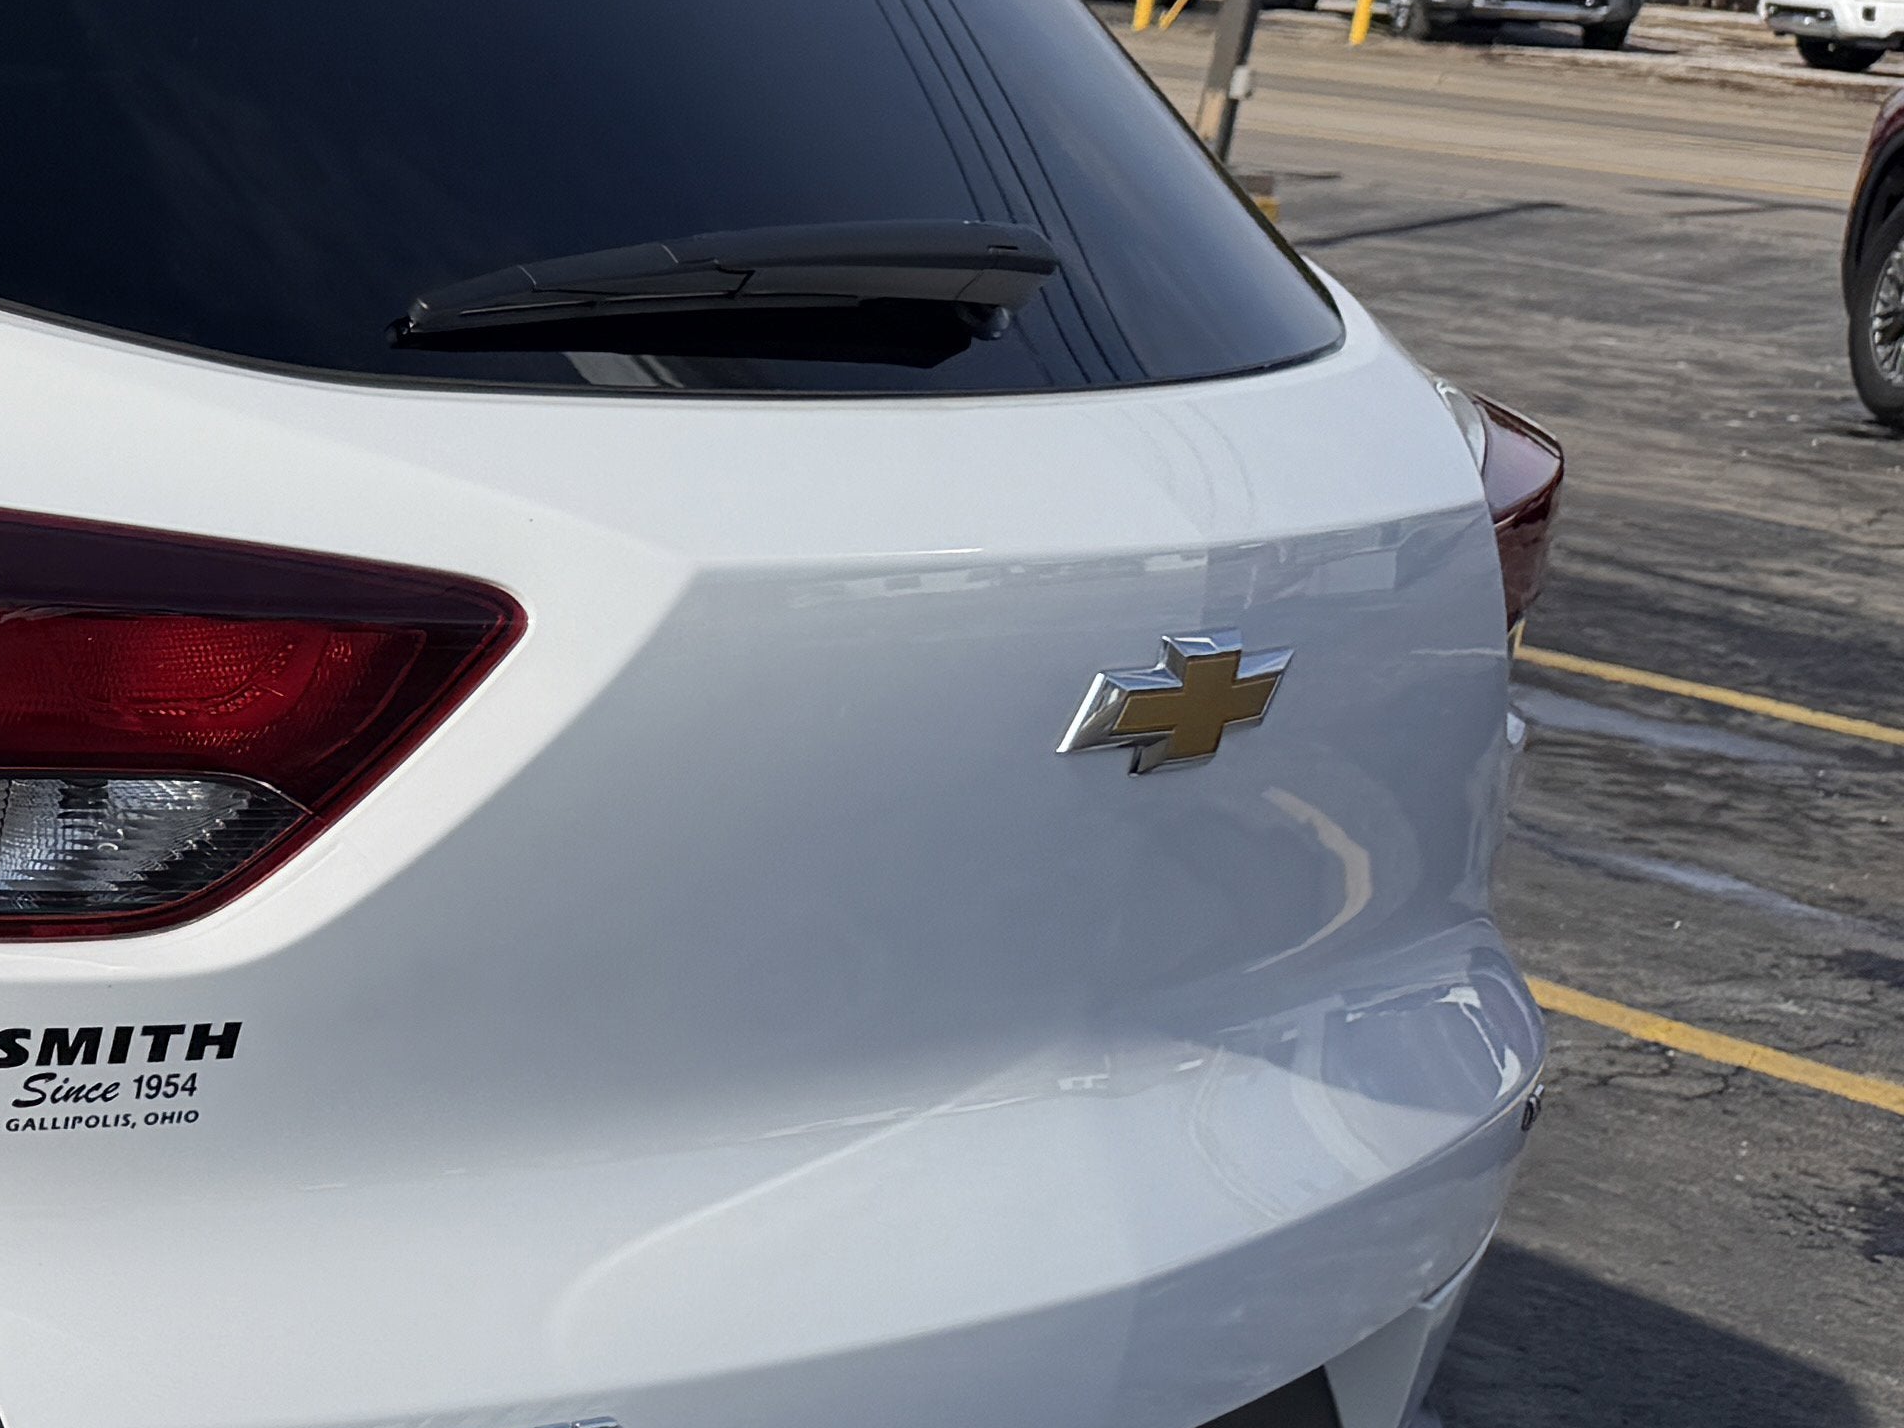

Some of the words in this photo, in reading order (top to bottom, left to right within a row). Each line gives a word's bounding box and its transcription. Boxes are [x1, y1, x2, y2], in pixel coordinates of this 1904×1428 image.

[11, 1072, 121, 1108] Since
[132, 1072, 199, 1100] 1954
[5, 1112, 137, 1132] GALLIPOLIS,
[143, 1109, 200, 1126] OHIO
